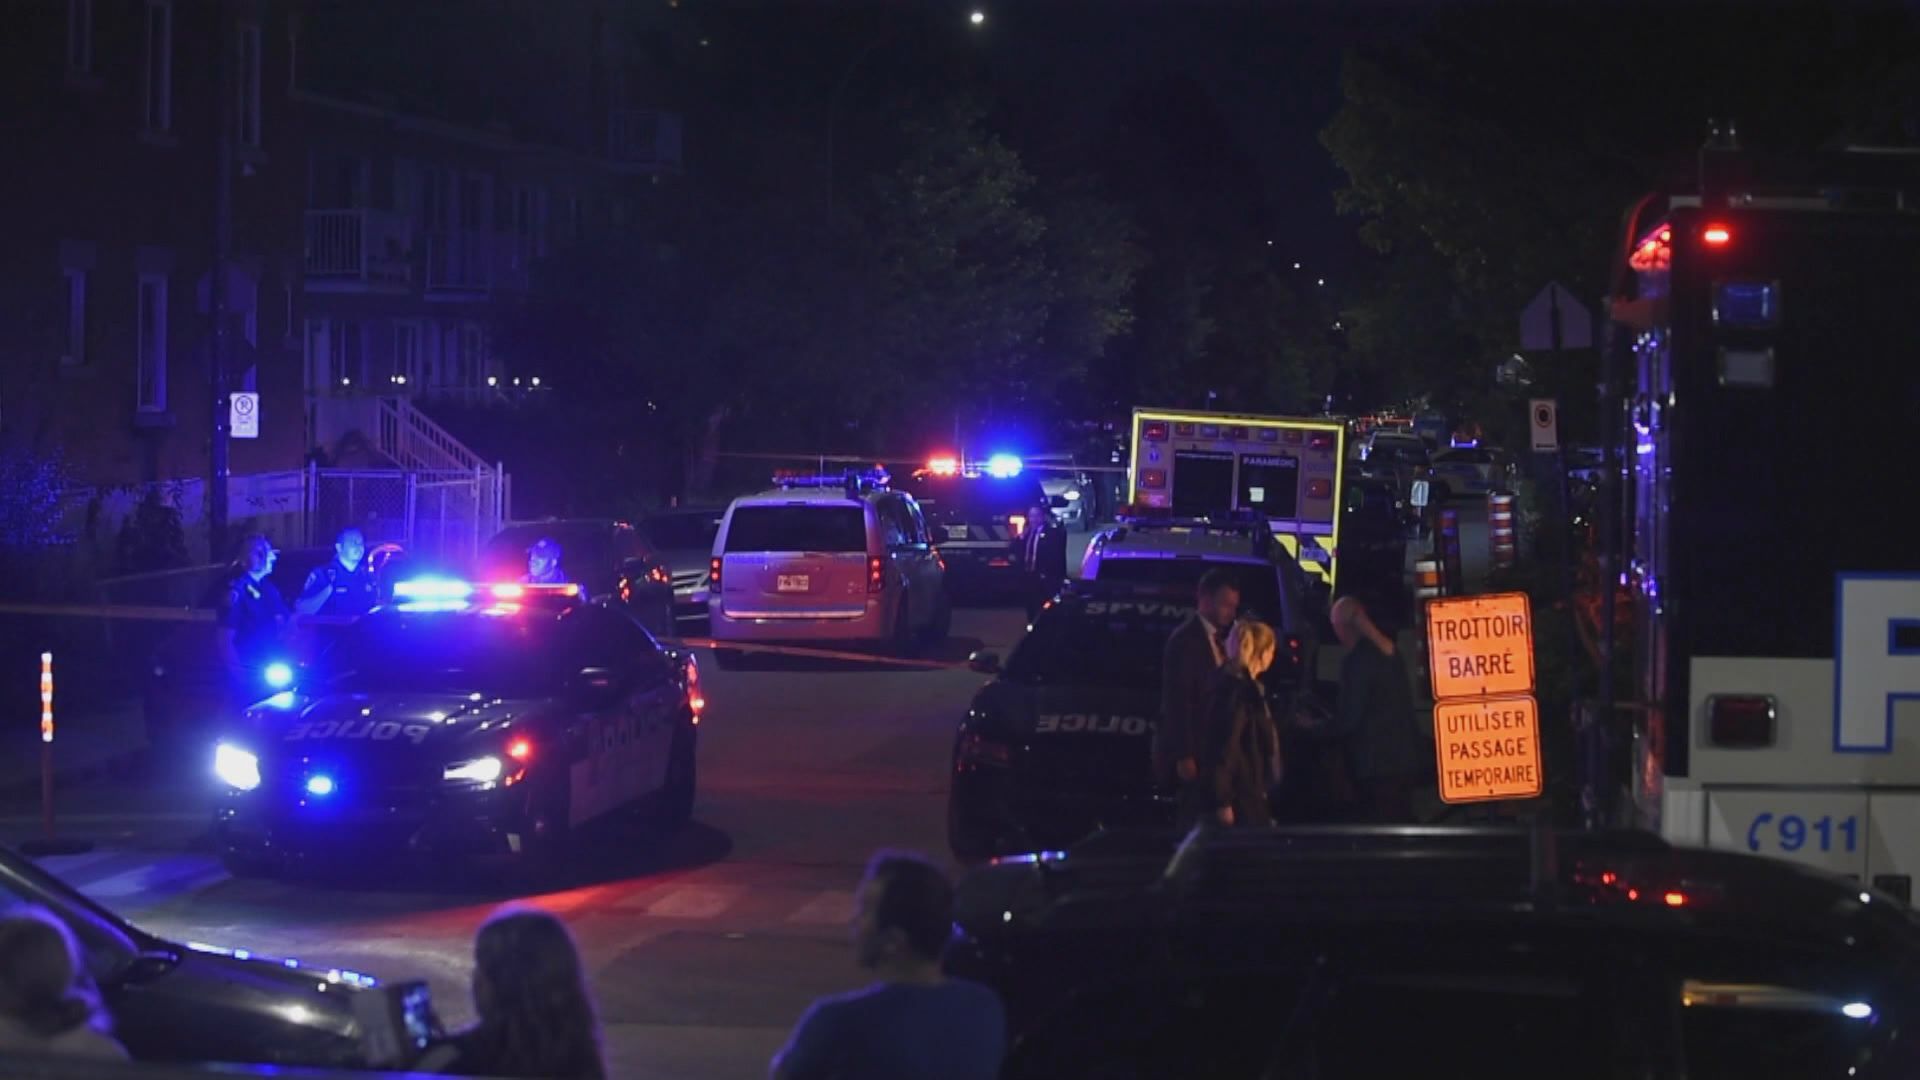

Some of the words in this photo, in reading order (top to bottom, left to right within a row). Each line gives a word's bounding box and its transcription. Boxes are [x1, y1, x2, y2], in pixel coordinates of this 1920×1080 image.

[1435, 615, 1524, 641] TROTTOIR
[1448, 648, 1515, 679] BARRÉ
[1447, 711, 1526, 734] UTILISER
[1450, 738, 1527, 760] PASSAGE
[1447, 766, 1534, 788] TEMPORAIRE
[1778, 815, 1858, 852] 911
